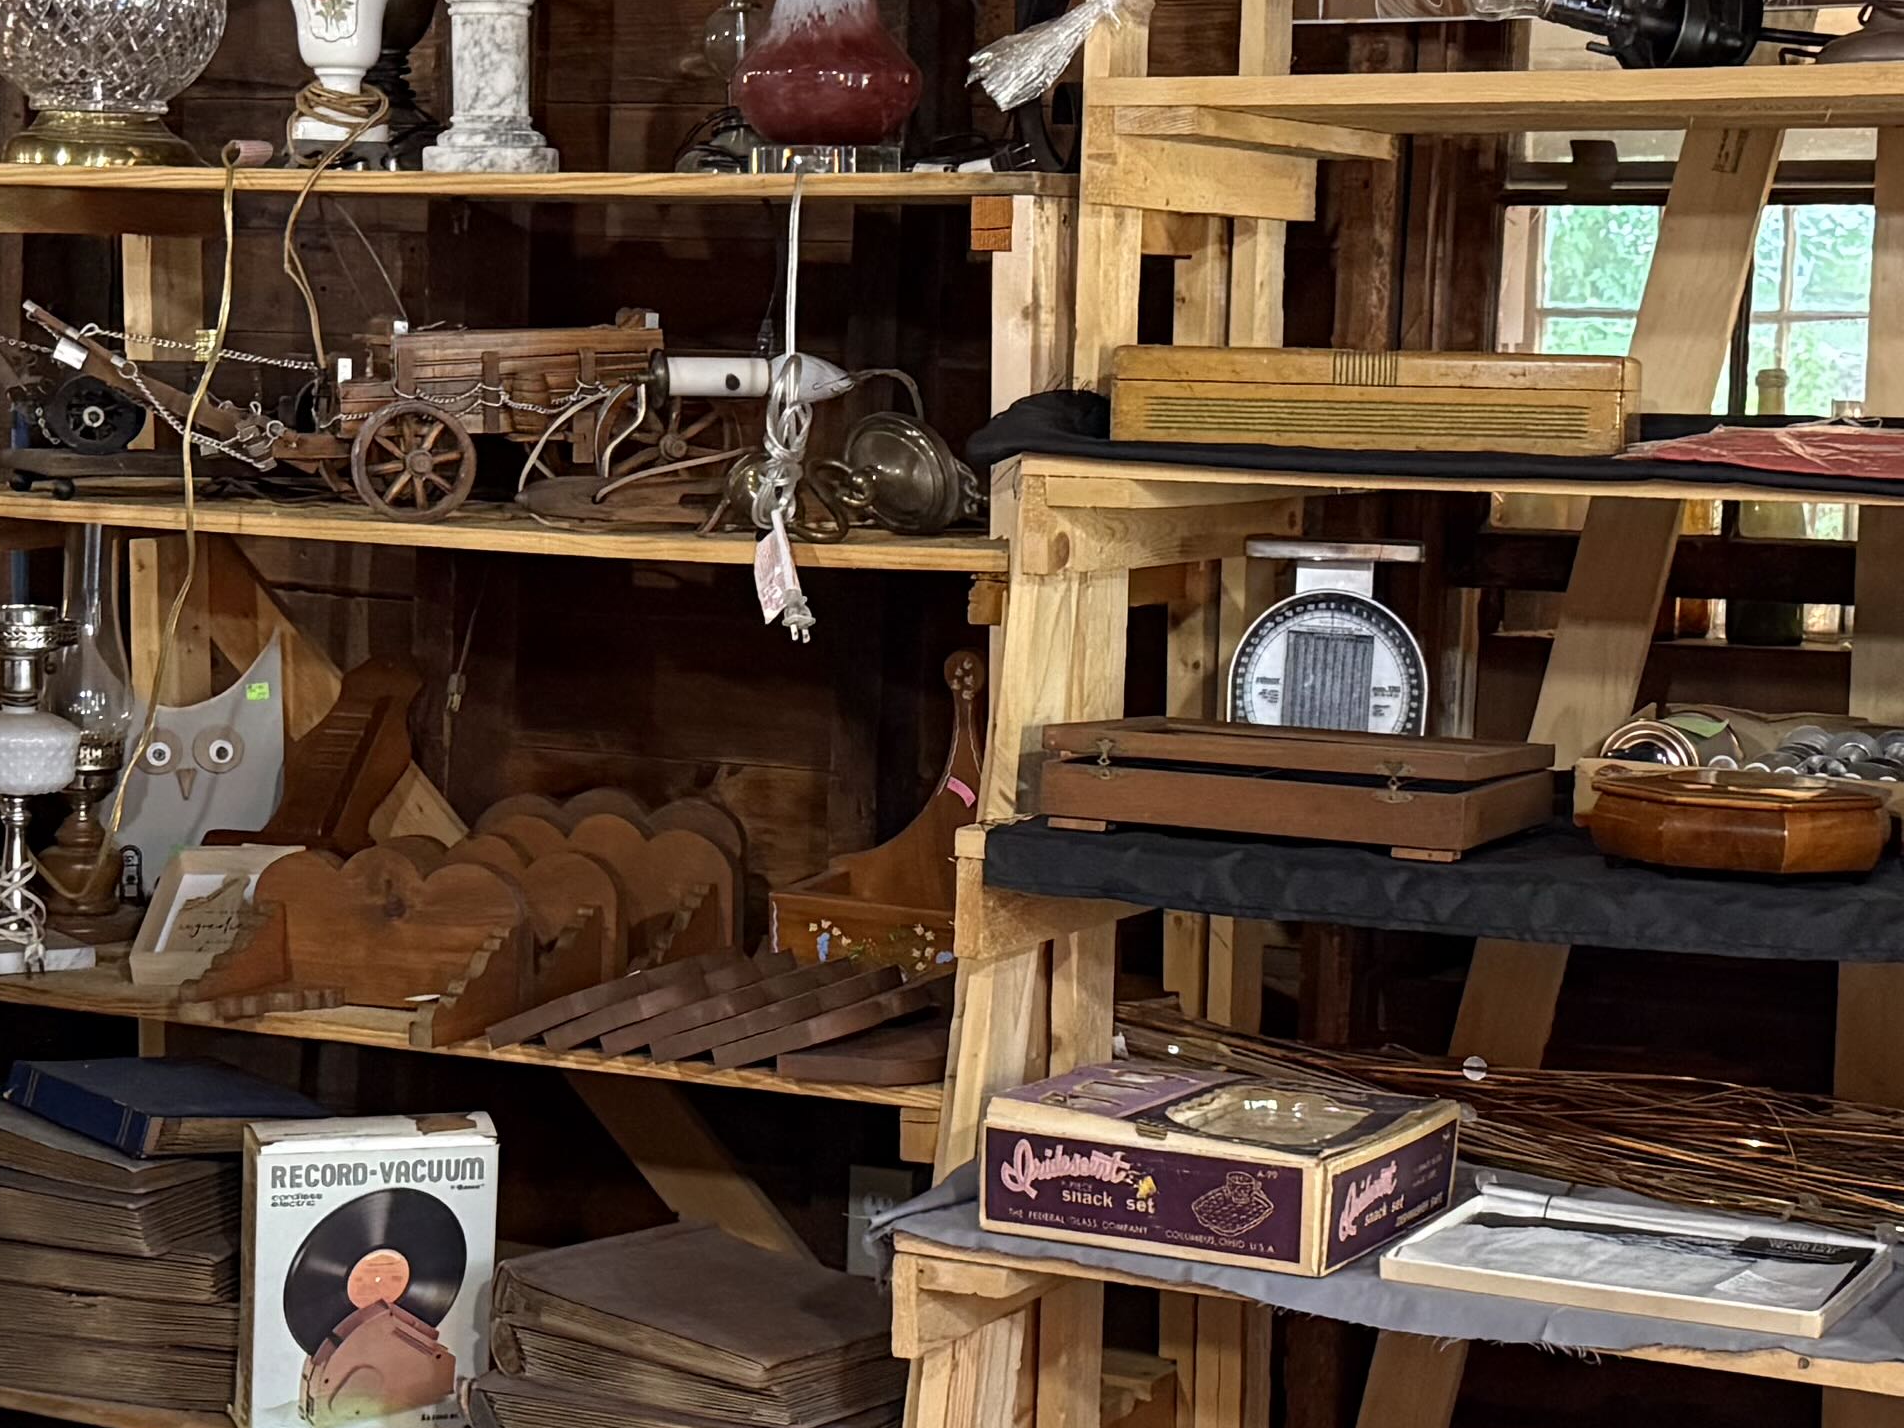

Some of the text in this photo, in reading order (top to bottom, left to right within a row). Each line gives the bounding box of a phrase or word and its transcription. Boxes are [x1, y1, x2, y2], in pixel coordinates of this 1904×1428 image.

[271, 1157, 485, 1189] RECORD-VACUUM
[1062, 1188, 1156, 1215] snack set
[1364, 1201, 1387, 1226] snack
[1392, 1194, 1404, 1212] set
[1028, 1210, 1065, 1224] FEDERAL
[1069, 1214, 1097, 1228] GLASS
[1102, 1220, 1149, 1235] COMPANY
